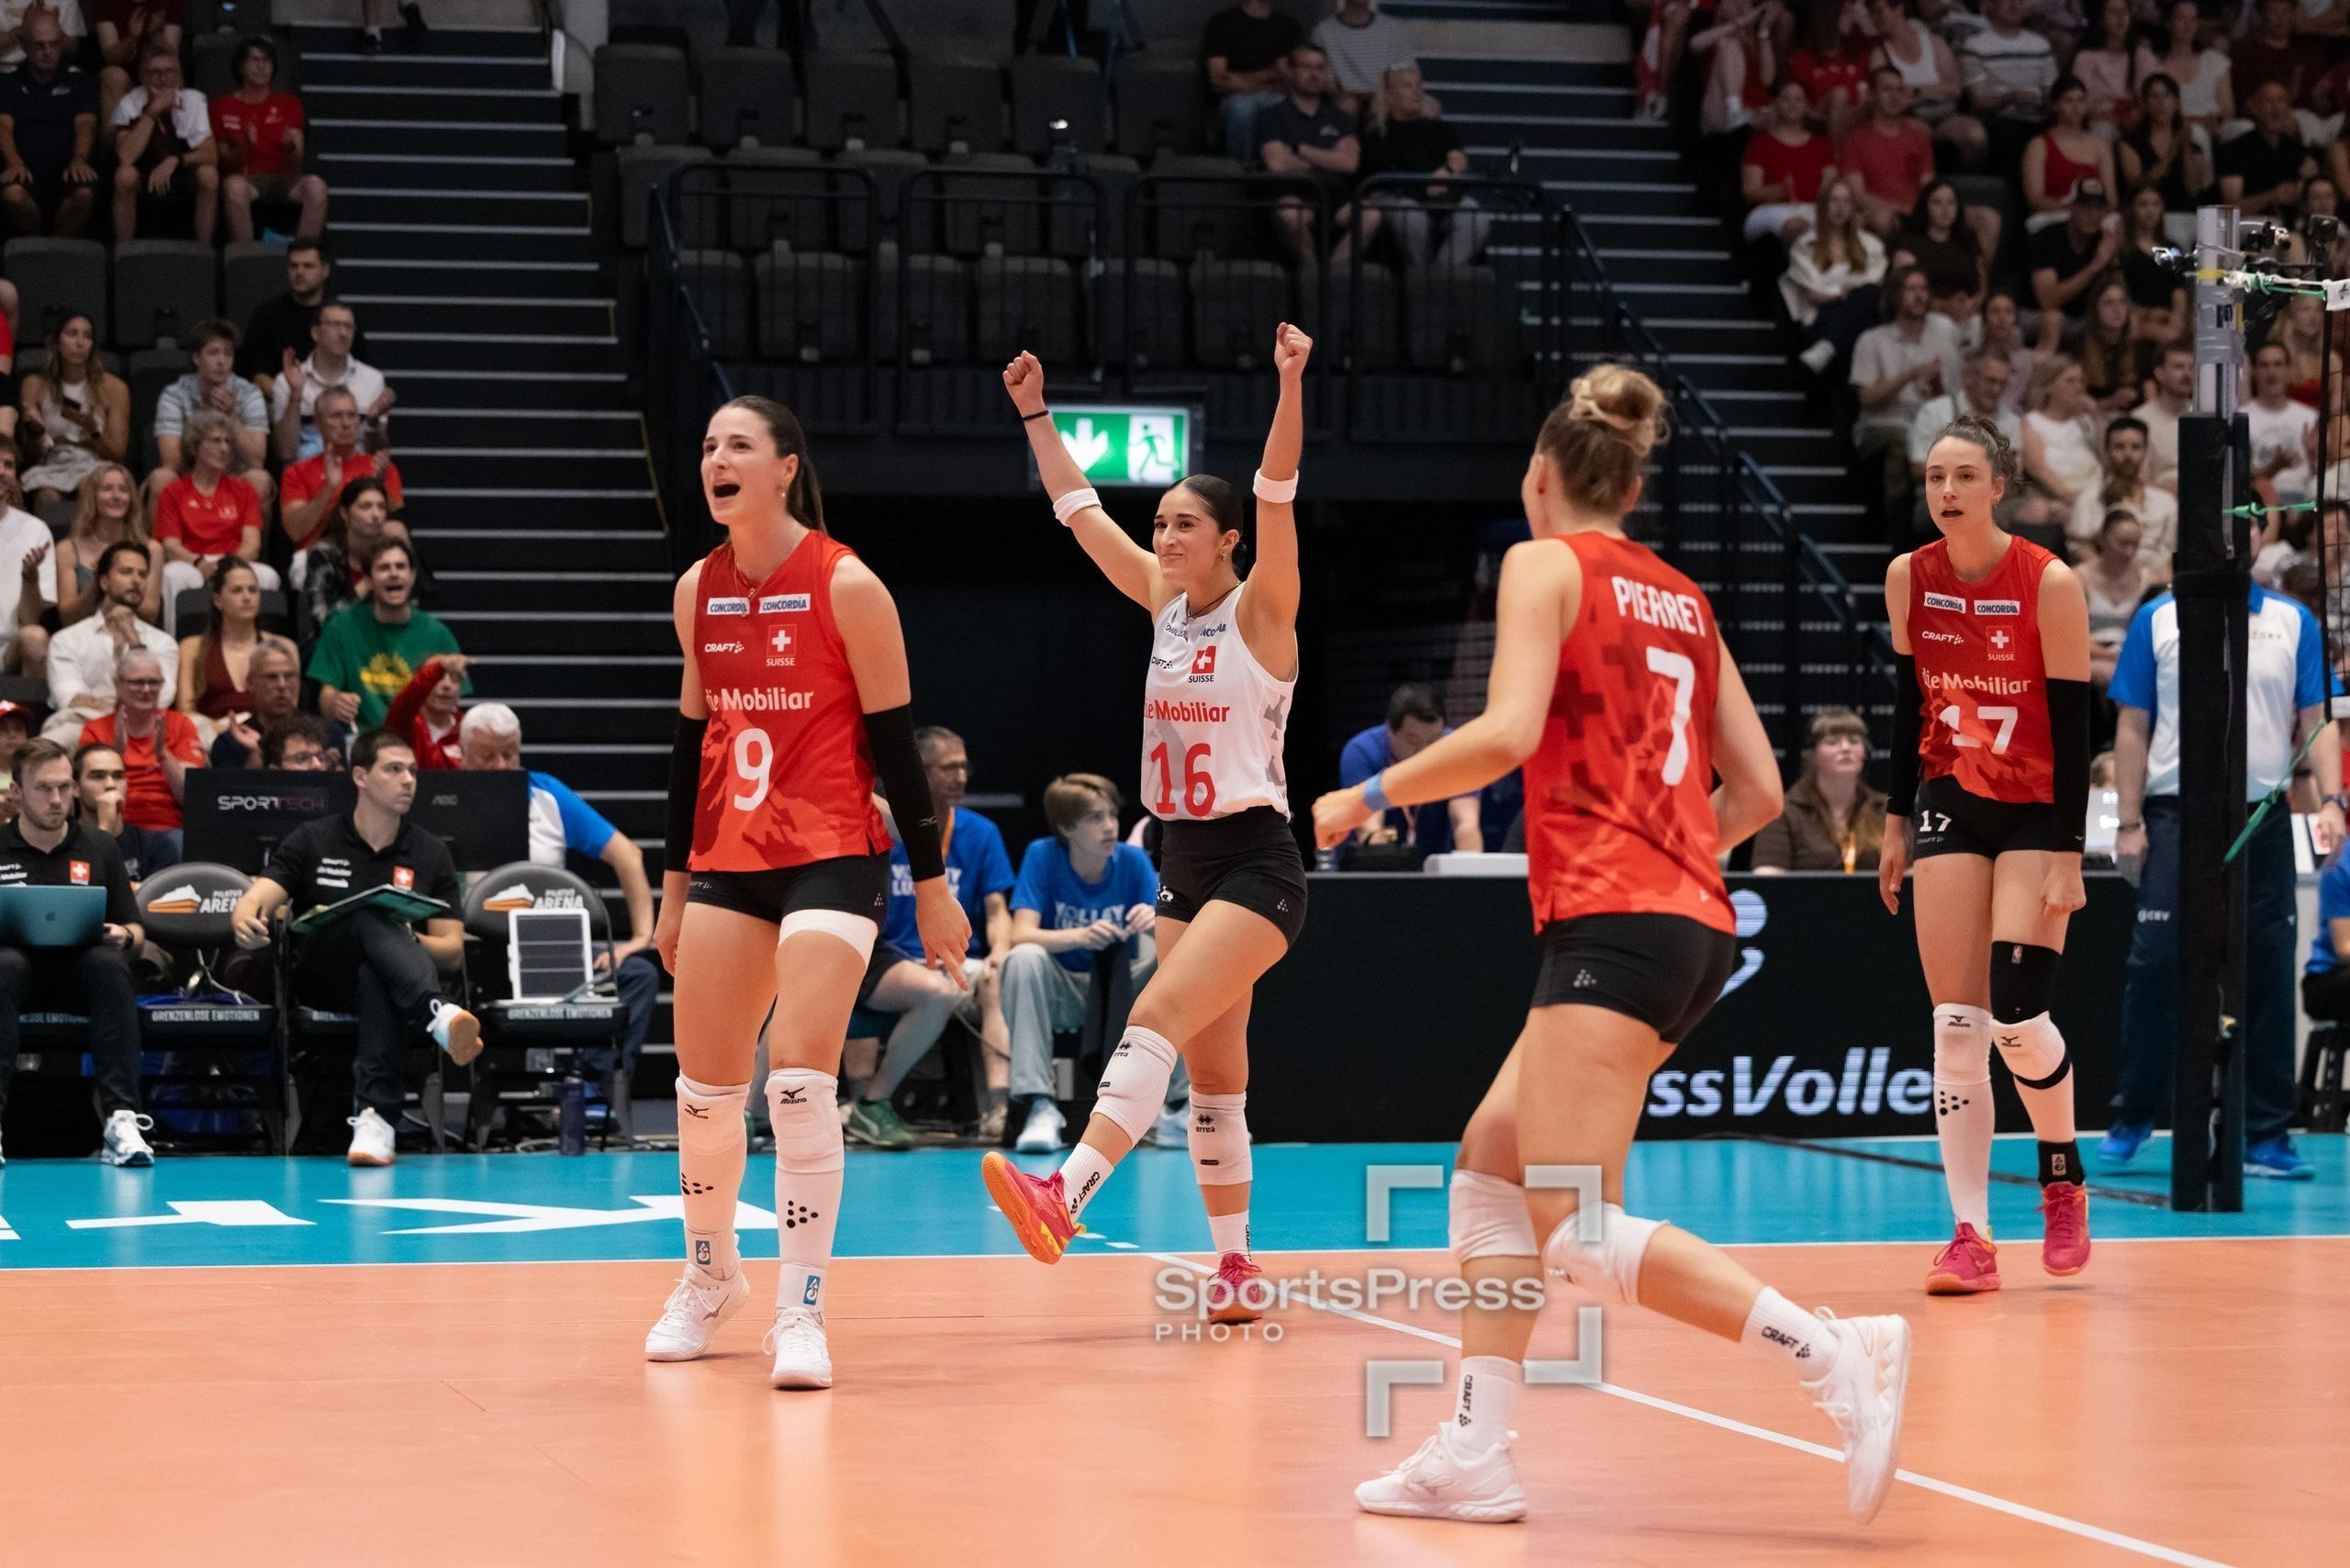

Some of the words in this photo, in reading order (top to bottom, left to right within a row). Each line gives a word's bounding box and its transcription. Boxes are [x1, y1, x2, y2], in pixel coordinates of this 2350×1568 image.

[1611, 576, 1706, 637] PIERRET
[704, 643, 736, 653] CRAFT
[1921, 631, 1954, 643] CRAFT
[767, 657, 795, 666] SUISSE
[1987, 653, 2015, 661] SUISSE
[1188, 675, 1214, 683] SUISSE
[1942, 672, 2031, 696] Mobiliar
[721, 687, 814, 711] Mobiliar
[1154, 700, 1230, 722] Mobiliar
[1646, 645, 1695, 787] 7
[1939, 705, 2018, 755] 17
[734, 728, 773, 811] 9
[1150, 742, 1216, 817] 16
[1919, 810, 1953, 832] 17
[1647, 1047, 1935, 1117] ssVolle
[1079, 1170, 1101, 1204] CRAFT
[1762, 1326, 1799, 1350] CRAFT
[1462, 1373, 1472, 1413] CRAFT
